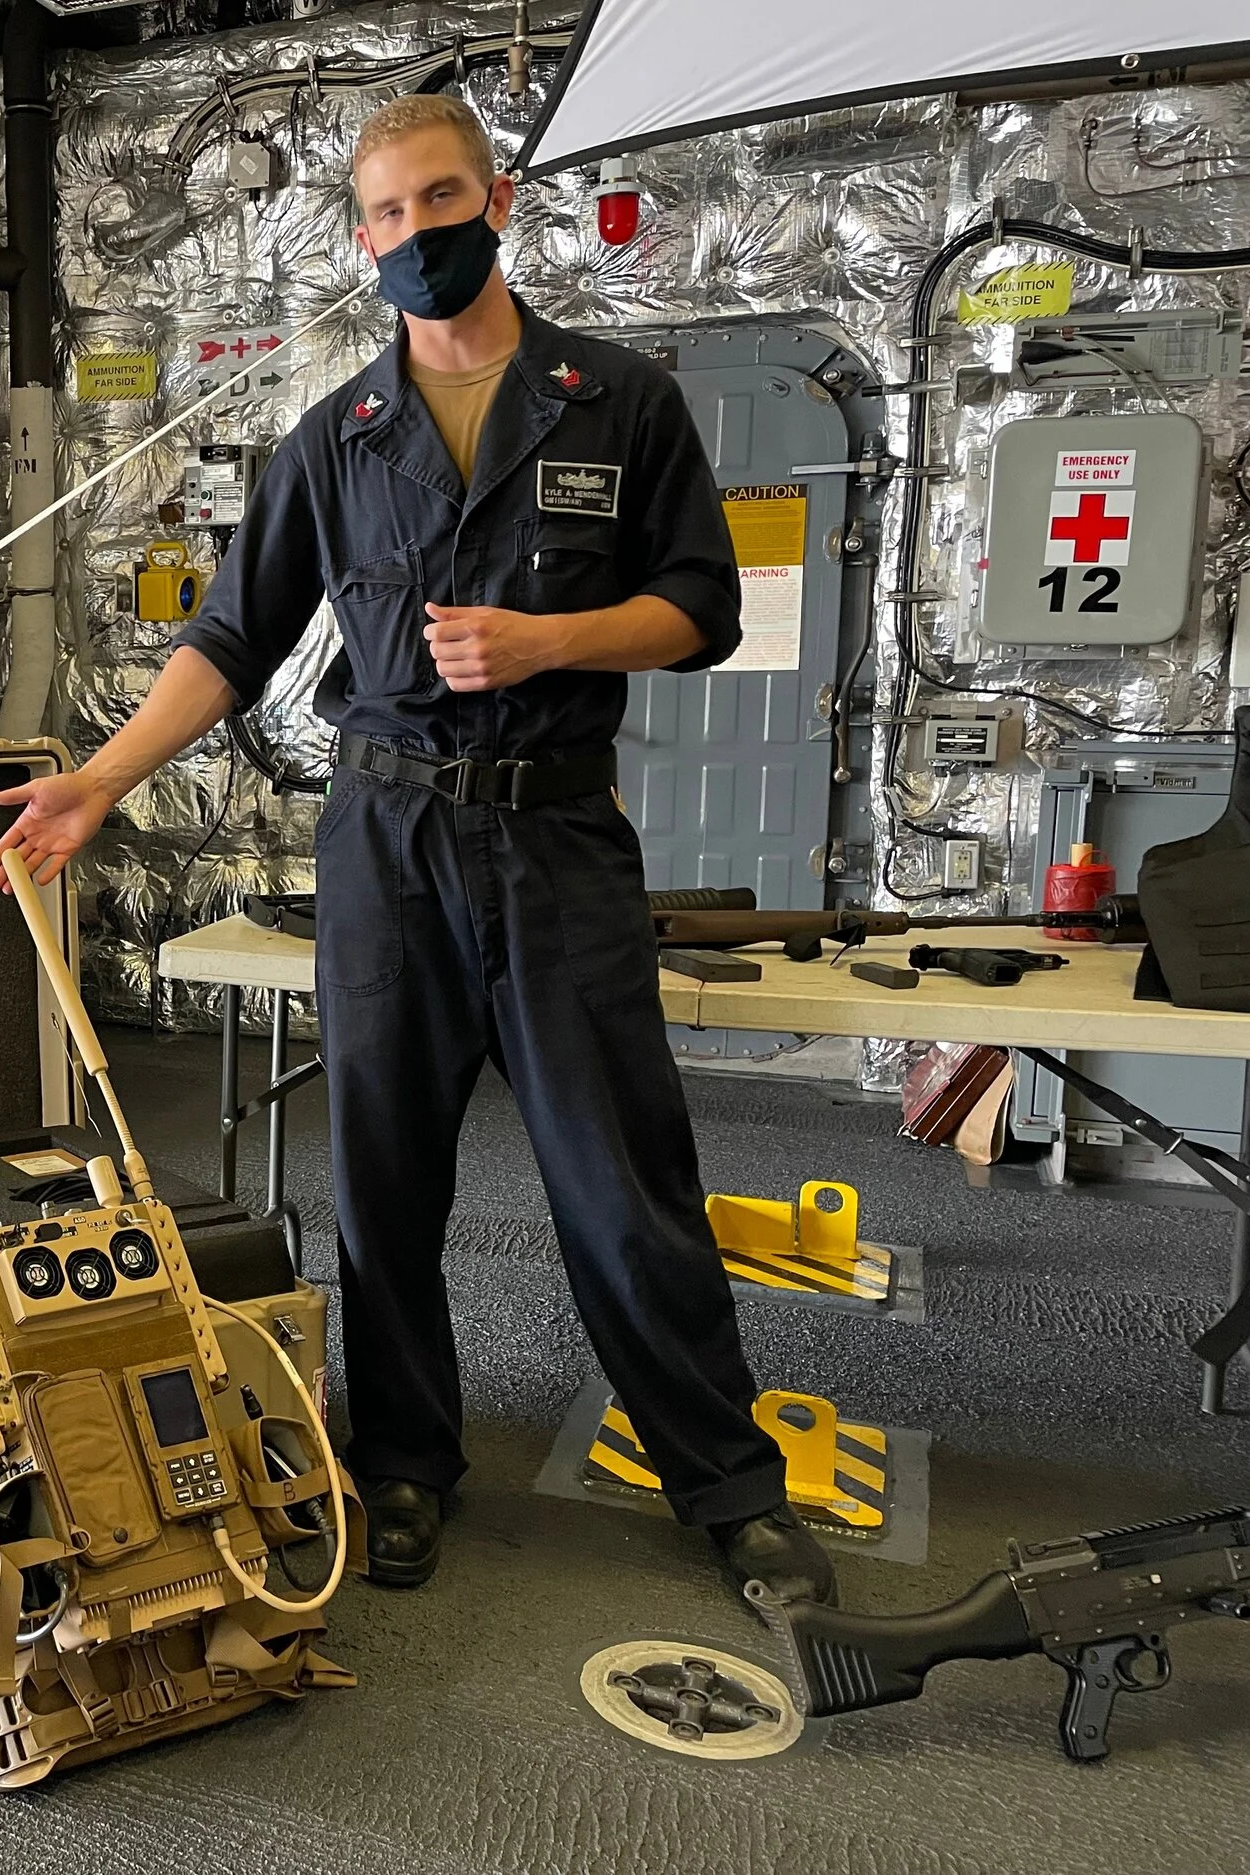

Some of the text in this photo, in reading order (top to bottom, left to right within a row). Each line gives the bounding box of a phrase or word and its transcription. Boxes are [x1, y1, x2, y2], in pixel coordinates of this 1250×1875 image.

[978, 279, 1055, 295] AMMUNITION
[984, 295, 1042, 308] FAR SIDE
[87, 365, 145, 377] AMMUNITION
[94, 376, 138, 388] FAR SIDE
[1062, 455, 1129, 466] EMERGENCY
[1068, 469, 1120, 480] USE ONLY
[725, 484, 800, 501] CAUTION
[739, 567, 789, 578] ARNING
[1038, 566, 1121, 613] 12
[283, 1481, 296, 1502] B
